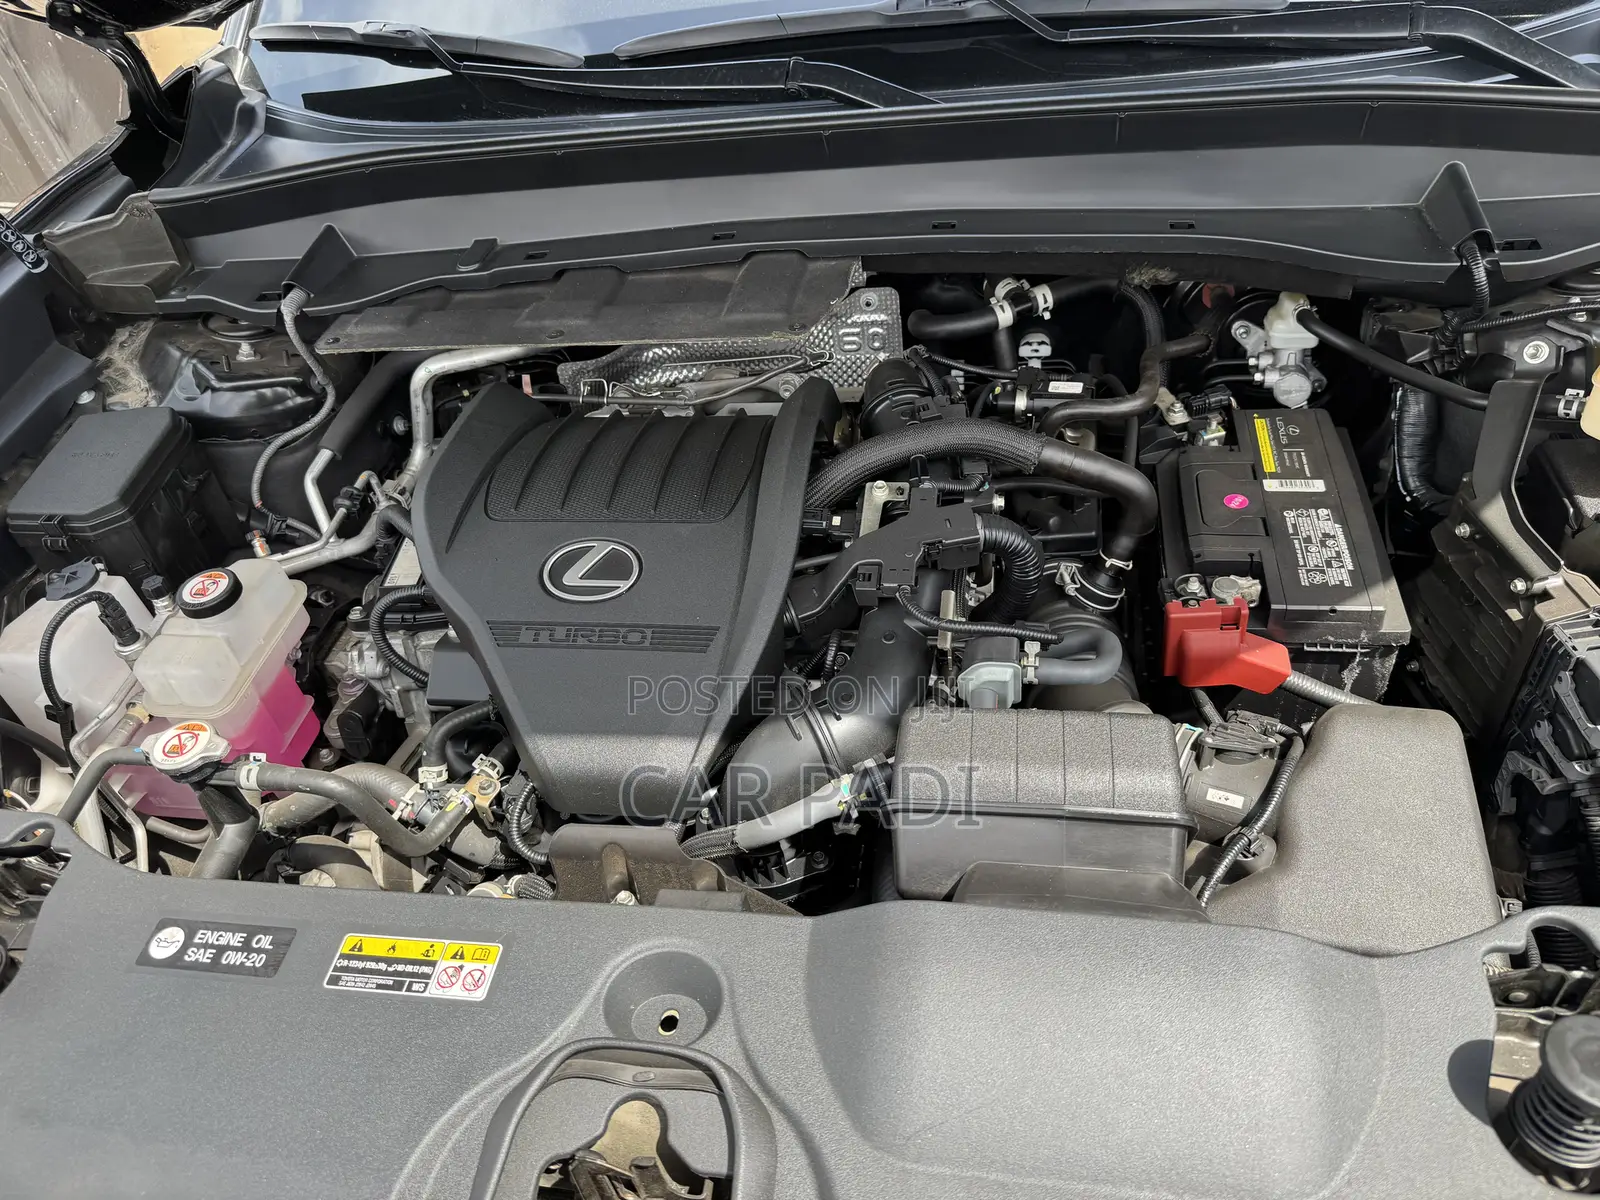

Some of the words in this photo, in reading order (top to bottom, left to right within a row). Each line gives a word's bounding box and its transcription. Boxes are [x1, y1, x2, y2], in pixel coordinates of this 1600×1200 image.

[1276, 416, 1288, 444] LEXUS
[524, 626, 649, 646] TURBO
[193, 929, 247, 947] ENGINE
[251, 934, 274, 949] OIL
[184, 947, 216, 963] SAE
[221, 950, 266, 967] 0W-20
[412, 982, 426, 991] WS
